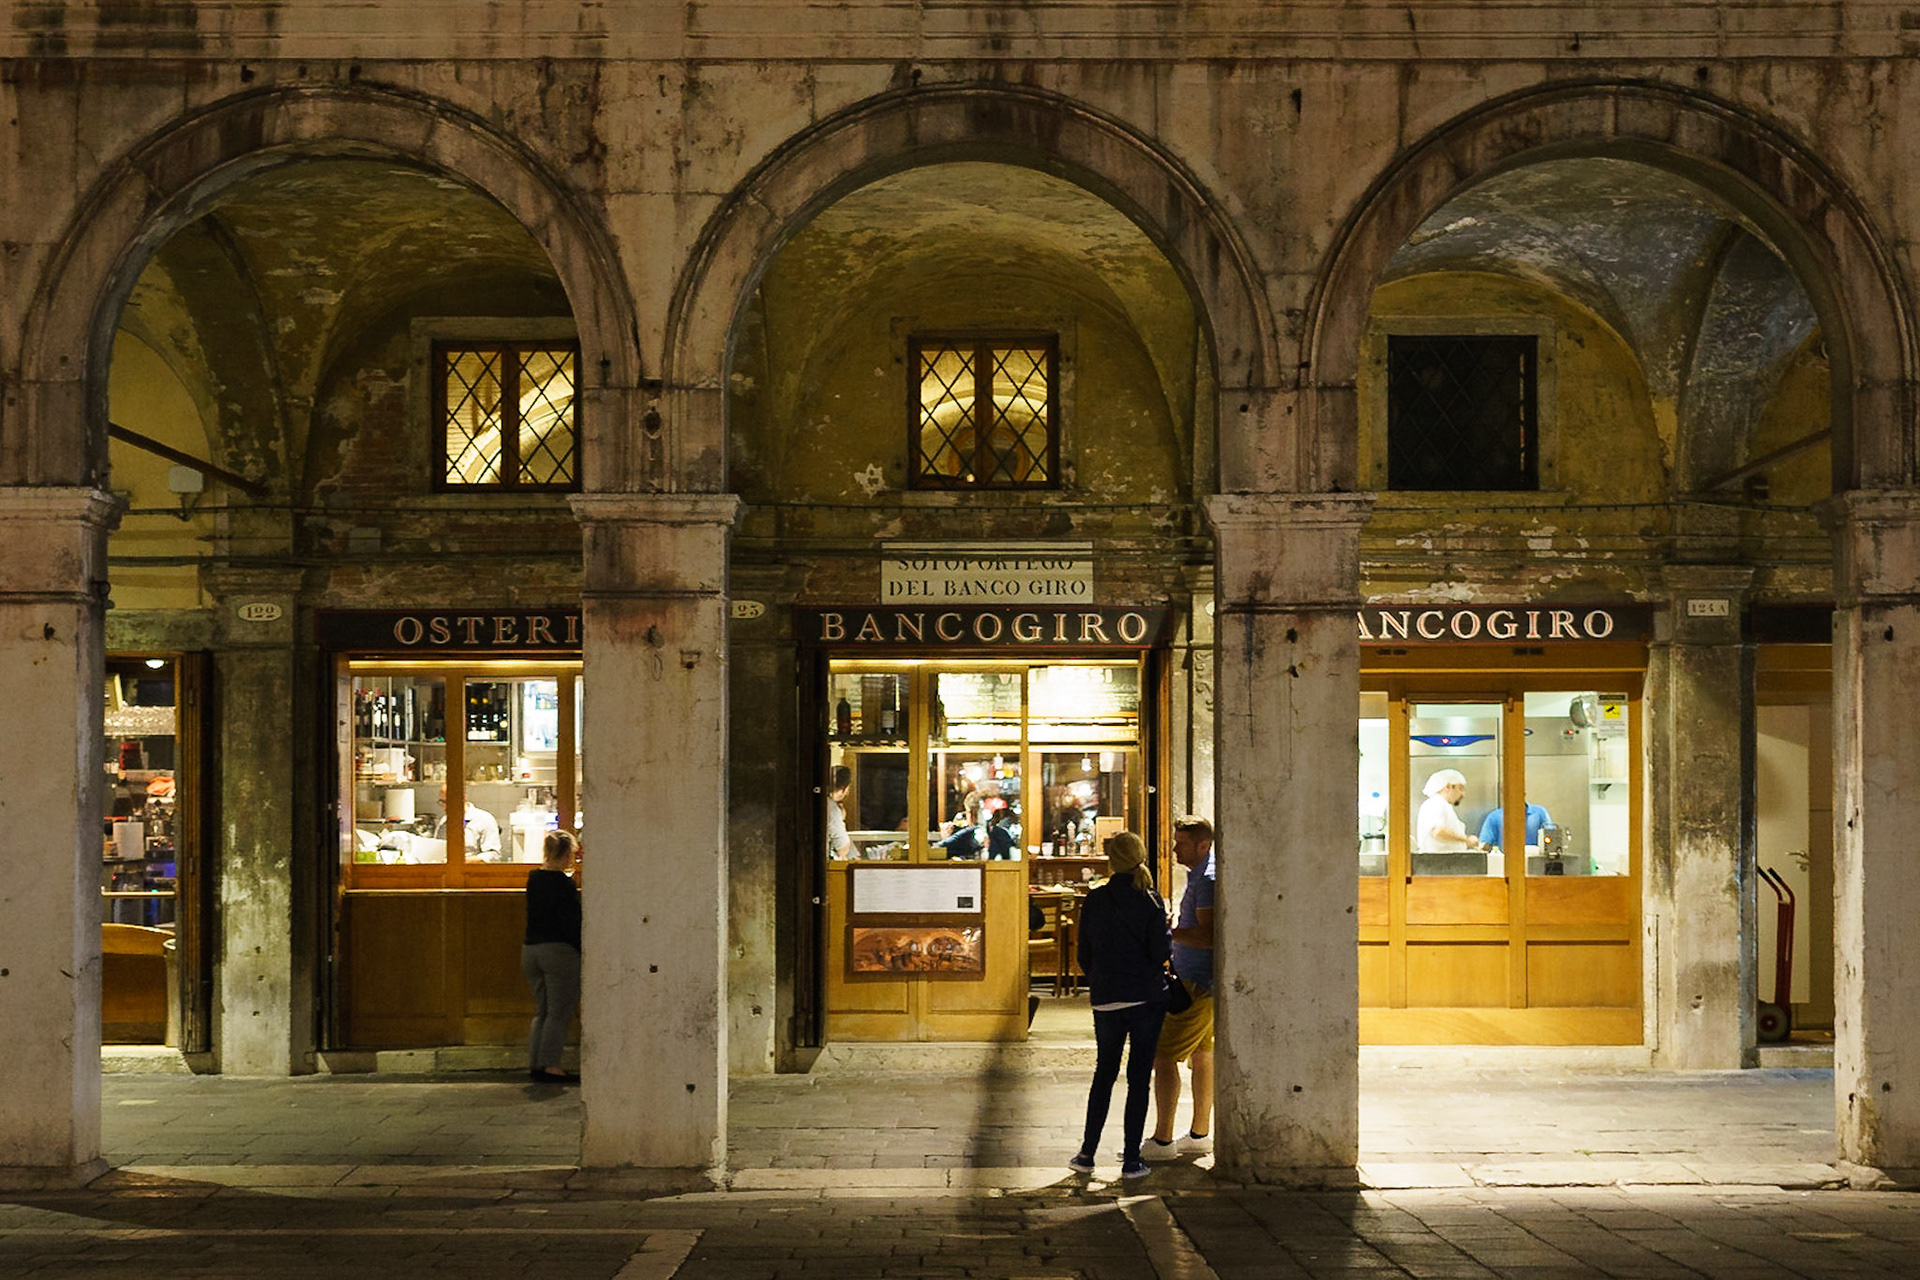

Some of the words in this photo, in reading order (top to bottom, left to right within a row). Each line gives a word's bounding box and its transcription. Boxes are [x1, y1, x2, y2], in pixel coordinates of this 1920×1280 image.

[889, 580, 935, 597] DEL
[944, 580, 1021, 597] BANCO
[1028, 580, 1086, 597] GIRO
[819, 612, 1148, 643] BANCOGIRO
